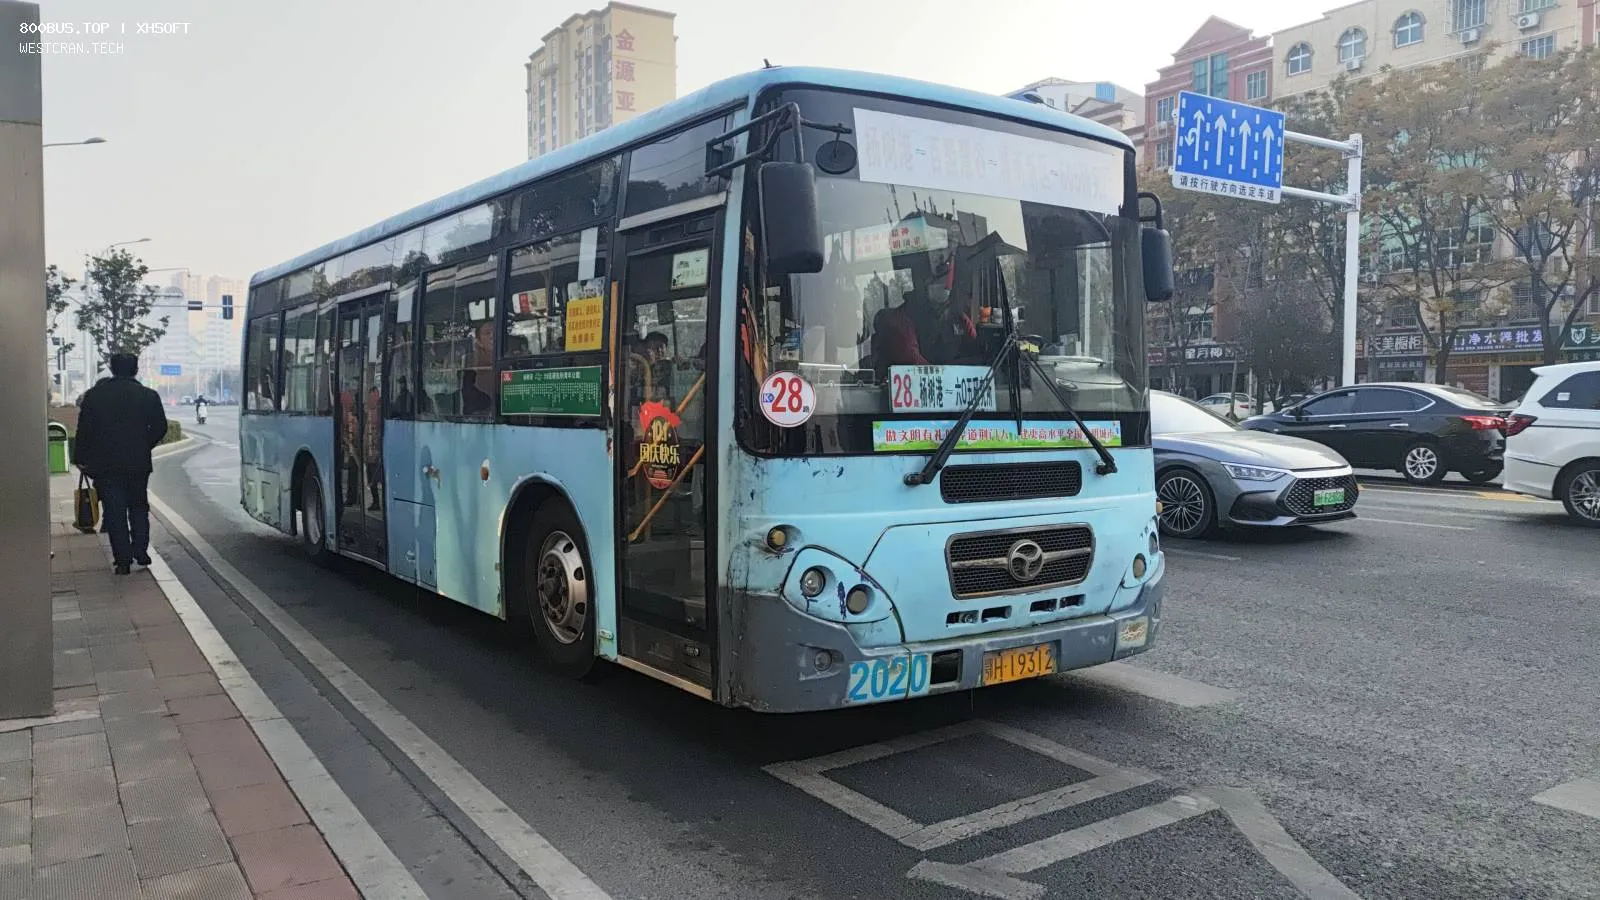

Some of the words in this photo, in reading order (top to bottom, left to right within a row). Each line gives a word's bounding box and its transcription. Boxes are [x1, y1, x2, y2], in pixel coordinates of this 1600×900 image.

[1180, 175, 1275, 201] 请按行驶方向选定车道
[640, 443, 681, 465] 国庆快乐
[849, 654, 929, 701] 2020
